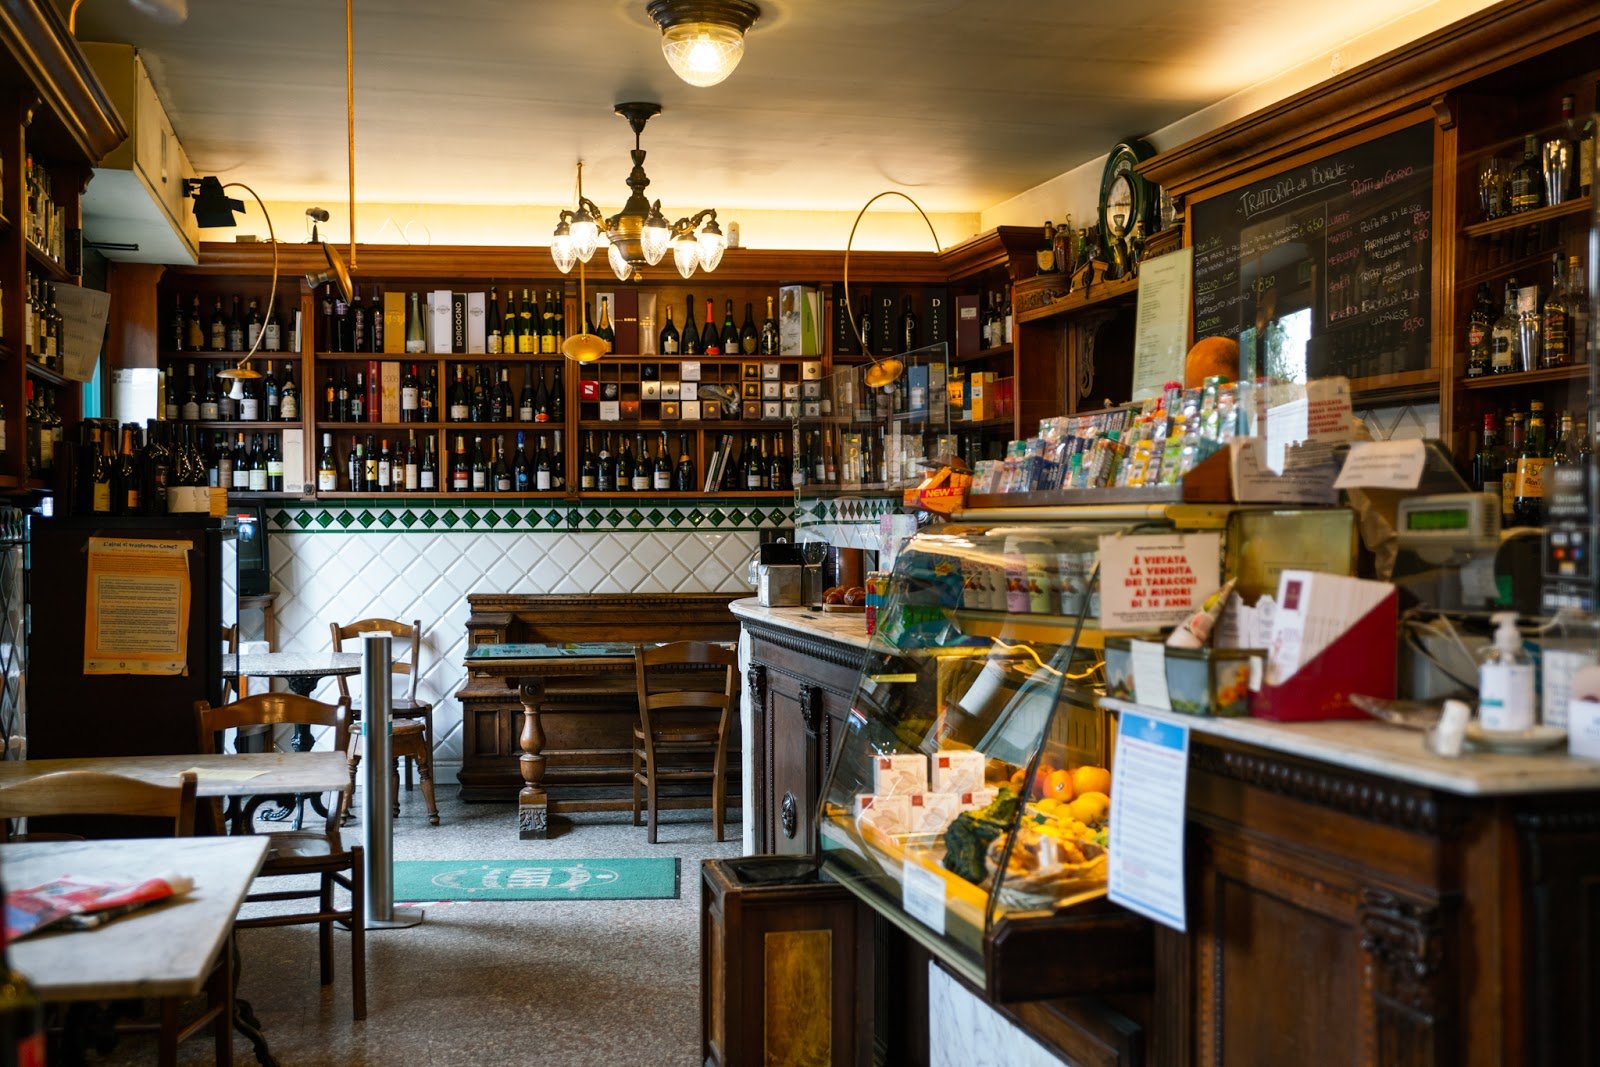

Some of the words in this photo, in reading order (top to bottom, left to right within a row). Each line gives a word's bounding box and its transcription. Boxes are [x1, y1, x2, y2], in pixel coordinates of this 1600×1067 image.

[455, 301, 463, 347] BORGOGNO
[931, 298, 941, 340] DIADEMA
[926, 488, 951, 498] NEW
[1145, 555, 1188, 565] VIETATA
[1129, 567, 1143, 576] LA
[1147, 566, 1192, 576] VENDITA
[1125, 578, 1142, 587] DEI
[1146, 576, 1197, 587] TABACCHI
[1136, 588, 1147, 597] AI
[1151, 588, 1191, 597] MINORI
[1131, 599, 1142, 609] DI
[1165, 598, 1191, 607] ANNI
